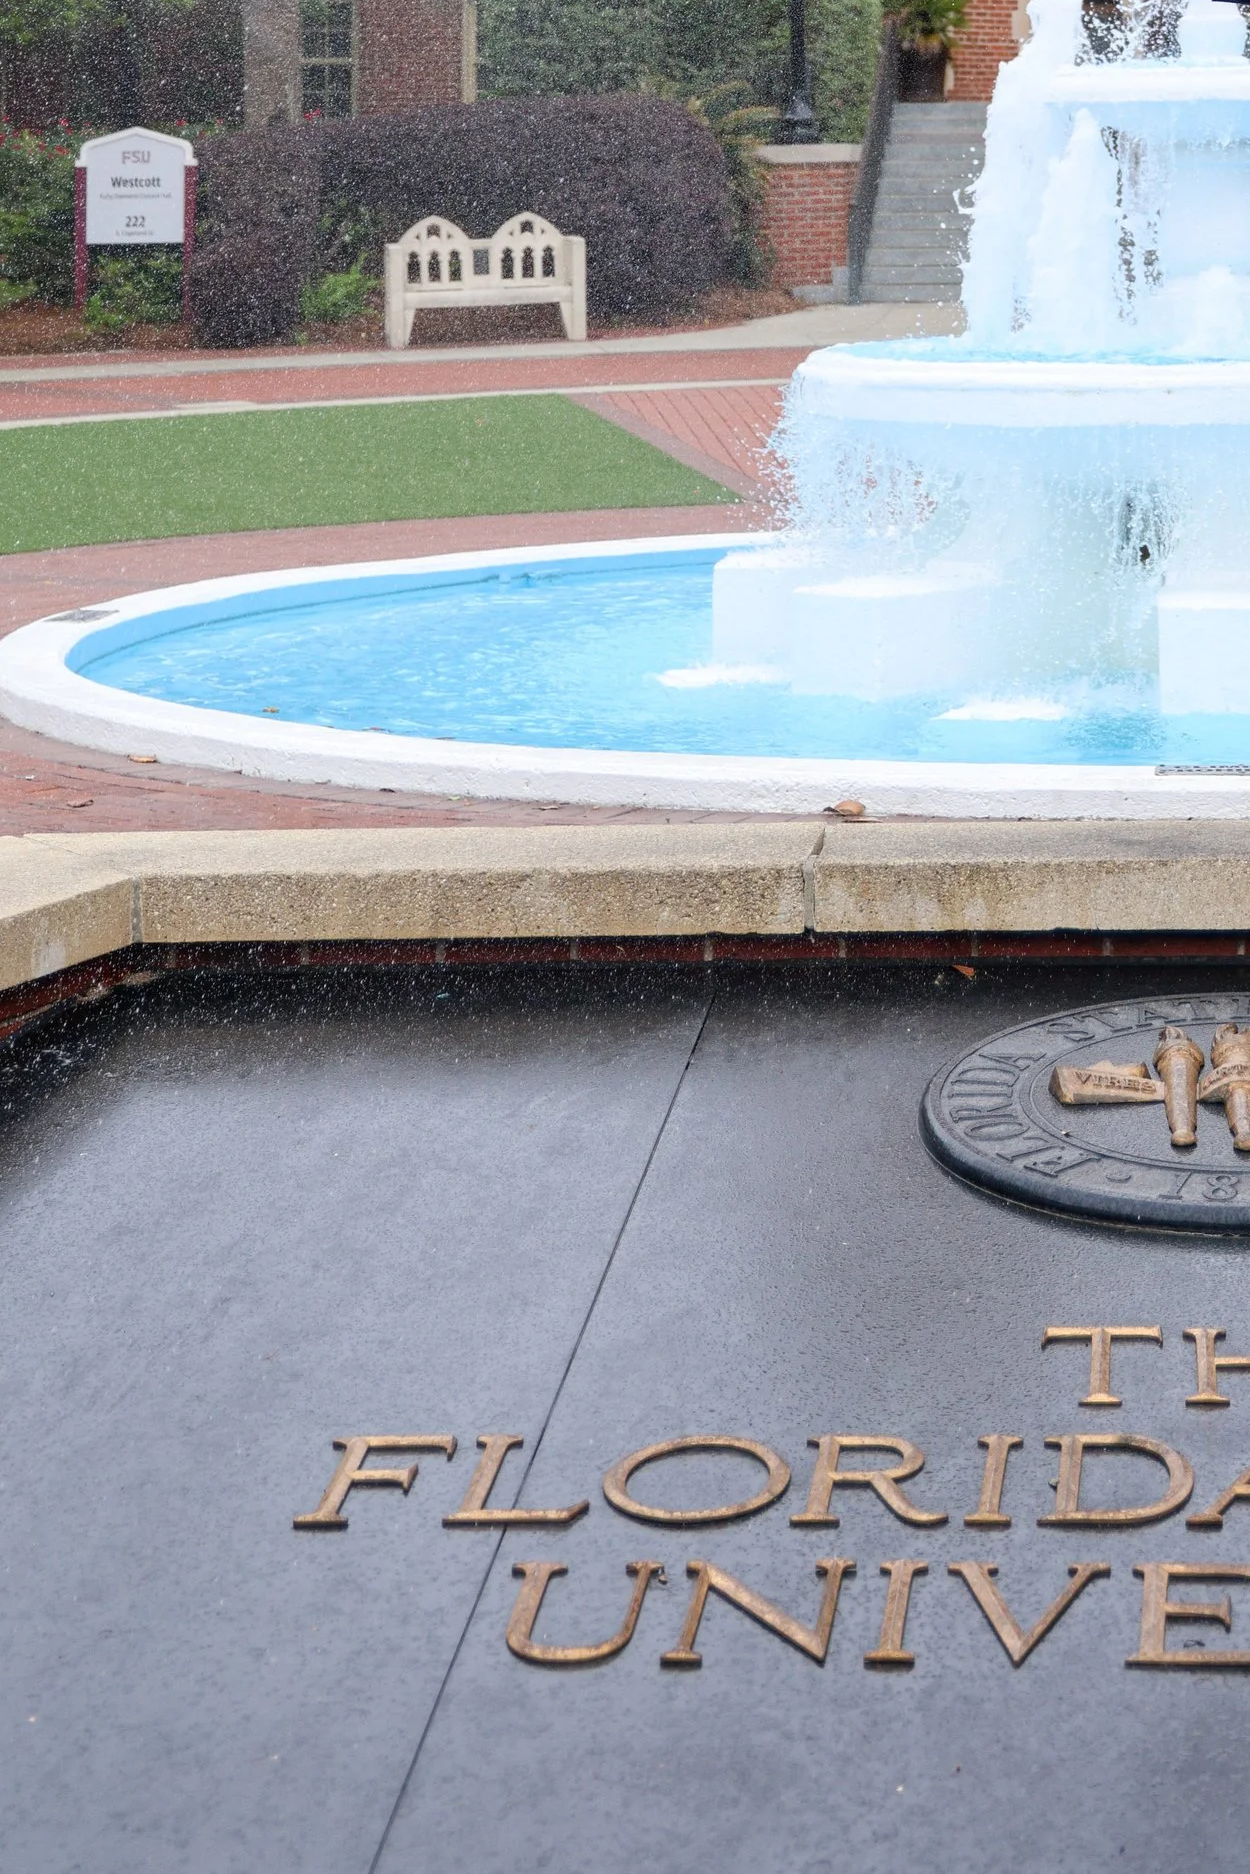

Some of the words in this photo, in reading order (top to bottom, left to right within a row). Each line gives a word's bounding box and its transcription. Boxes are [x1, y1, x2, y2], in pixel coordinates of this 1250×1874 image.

[121, 149, 151, 165] FSU
[110, 176, 162, 189] Westcott
[125, 214, 146, 228] 222
[1075, 1071, 1158, 1096] VIRES
[949, 1050, 1100, 1177] FLORIDA
